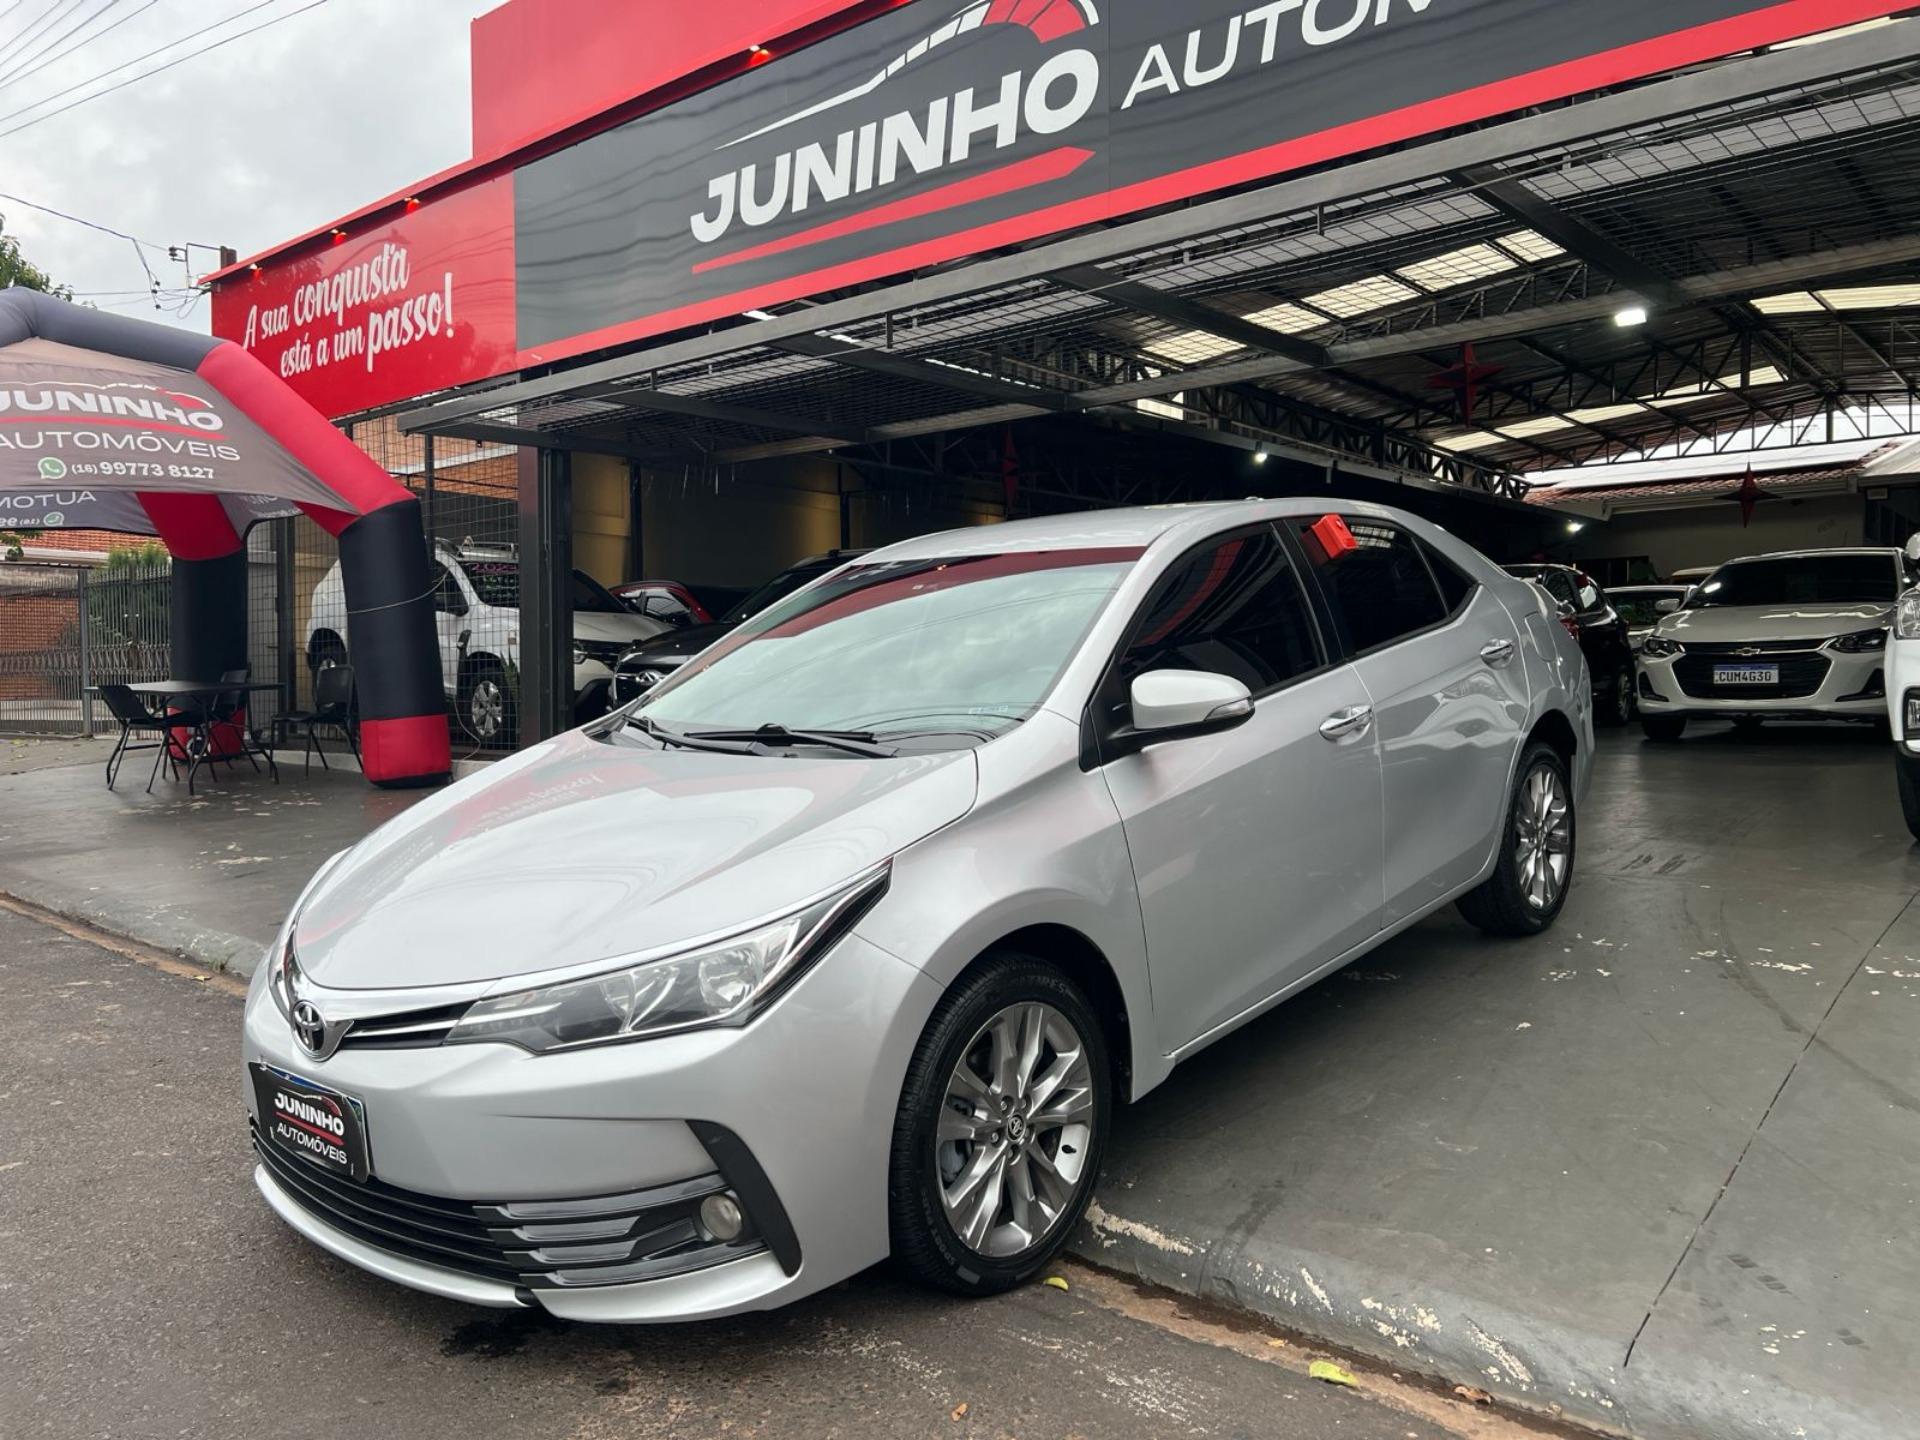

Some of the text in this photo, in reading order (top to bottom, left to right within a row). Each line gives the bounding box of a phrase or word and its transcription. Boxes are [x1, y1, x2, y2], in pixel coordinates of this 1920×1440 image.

[690, 48, 1099, 243] JUNINHO
[242, 304, 258, 350] A
[261, 304, 289, 339] sua
[281, 272, 454, 377] está a um passo!
[71, 461, 215, 479] (16) 99773 8127
[274, 1092, 345, 1136] JUNINHO
[276, 1122, 348, 1165] AUTOMÓVEIS
